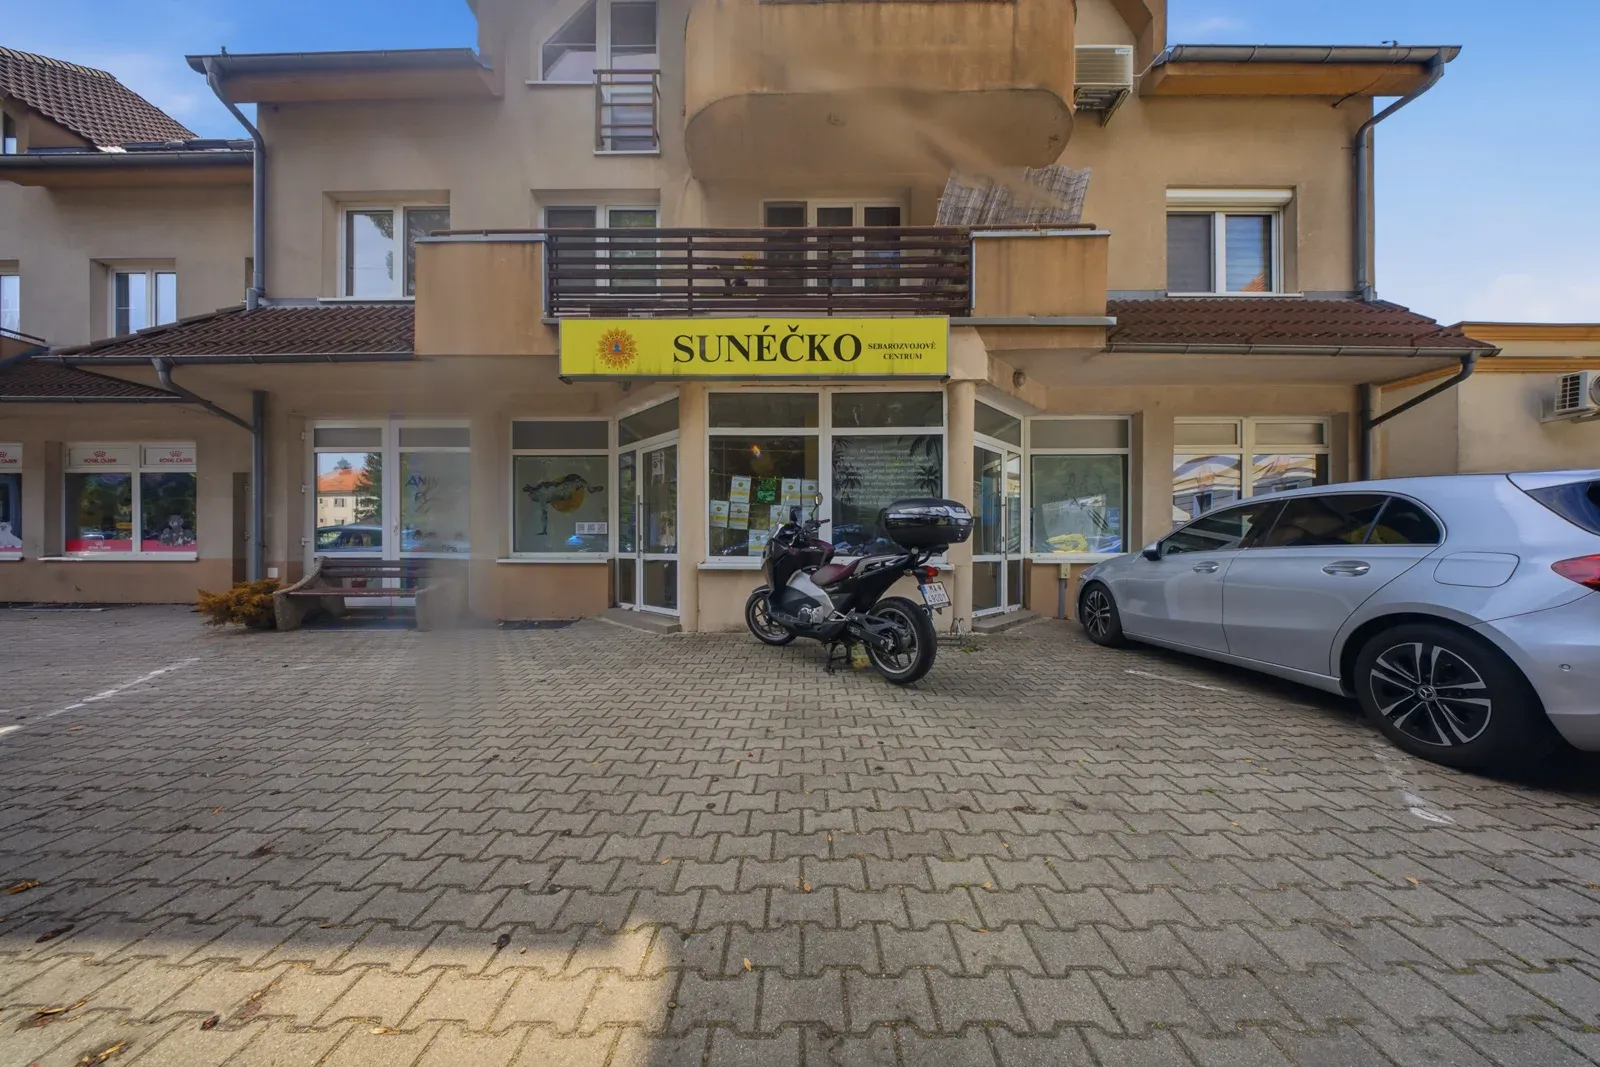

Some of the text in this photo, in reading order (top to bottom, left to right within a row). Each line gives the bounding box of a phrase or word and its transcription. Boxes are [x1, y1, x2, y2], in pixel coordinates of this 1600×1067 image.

[673, 325, 862, 363] SUNÉČKO
[868, 341, 936, 351] SEBAROZVOJOVÉ
[883, 353, 922, 361] CENTRUM
